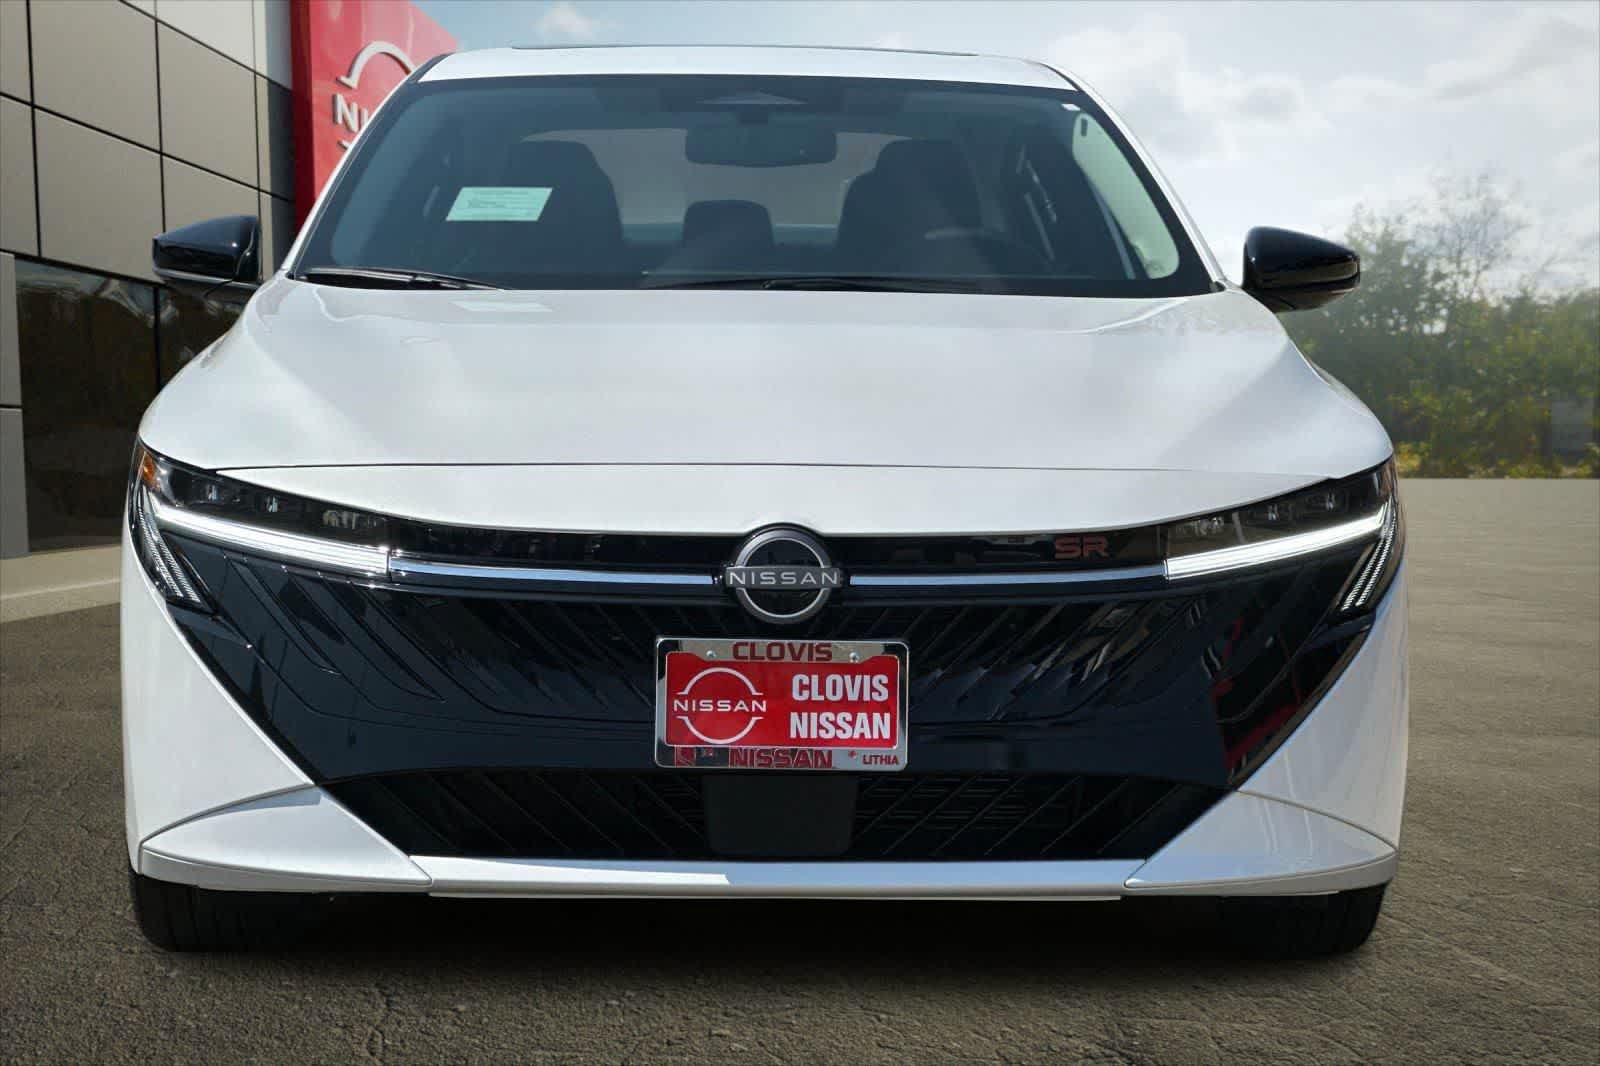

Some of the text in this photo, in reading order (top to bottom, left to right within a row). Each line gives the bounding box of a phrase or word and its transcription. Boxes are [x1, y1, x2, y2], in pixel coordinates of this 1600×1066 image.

[1054, 536, 1109, 560] SR
[729, 571, 839, 586] NISSAN
[732, 642, 833, 662] CLOVIS
[792, 674, 889, 702] CLOVIS
[673, 699, 767, 712] NISSAN
[790, 711, 891, 740] NISSAN
[729, 748, 833, 769] NISSAN
[863, 755, 899, 766] LITHIA
